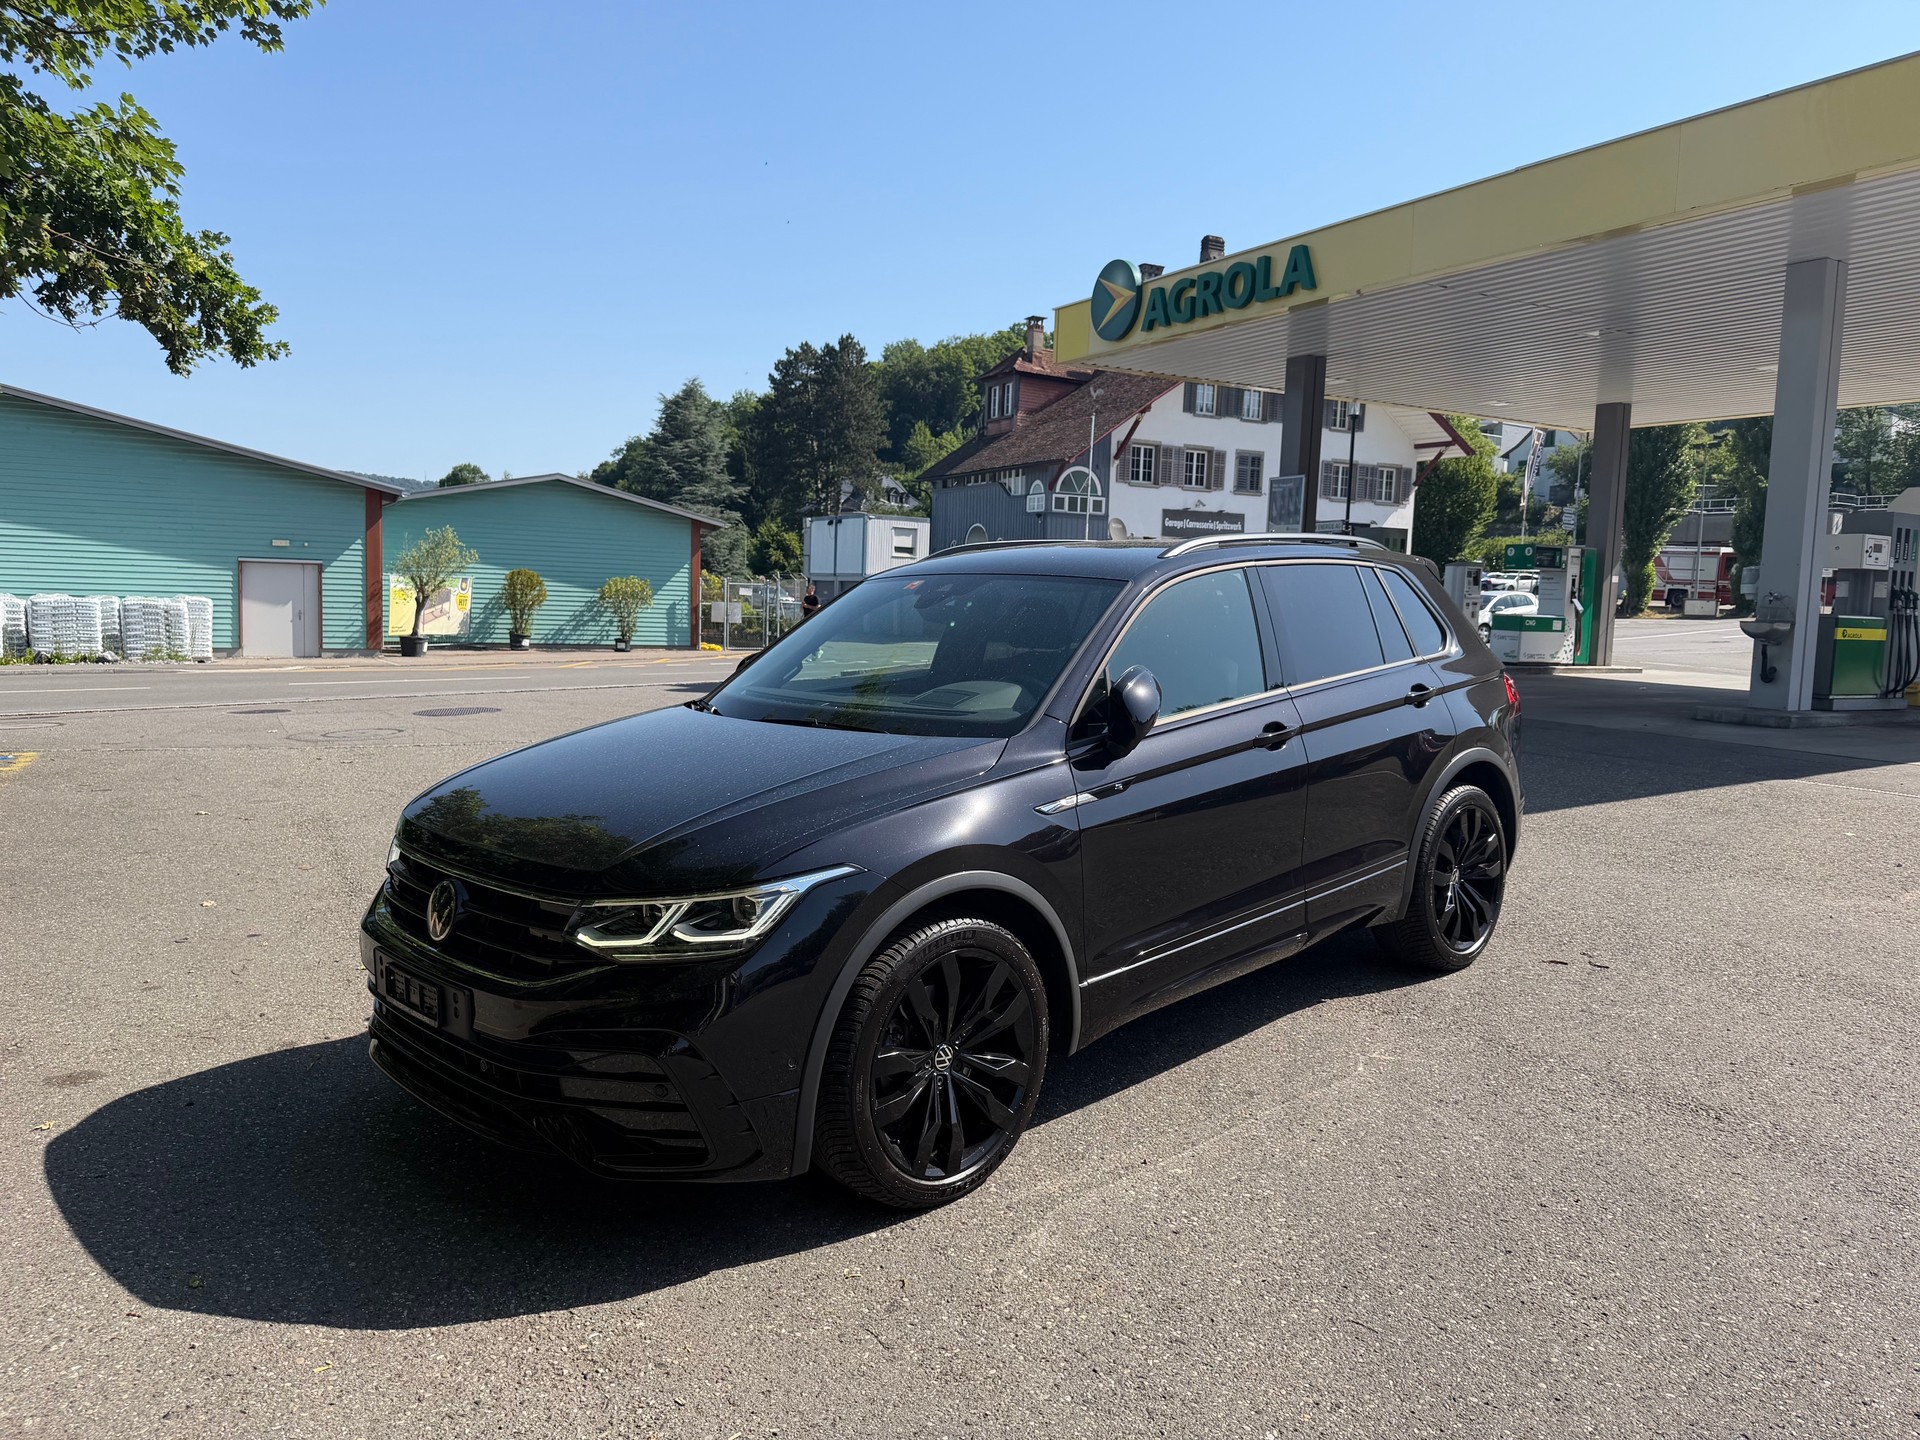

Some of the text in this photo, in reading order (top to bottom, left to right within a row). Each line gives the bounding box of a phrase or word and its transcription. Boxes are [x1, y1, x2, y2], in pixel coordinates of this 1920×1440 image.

[1141, 244, 1316, 332] AGROLA
[1164, 517, 1183, 529] Garage
[1186, 519, 1214, 529] Carrosserie
